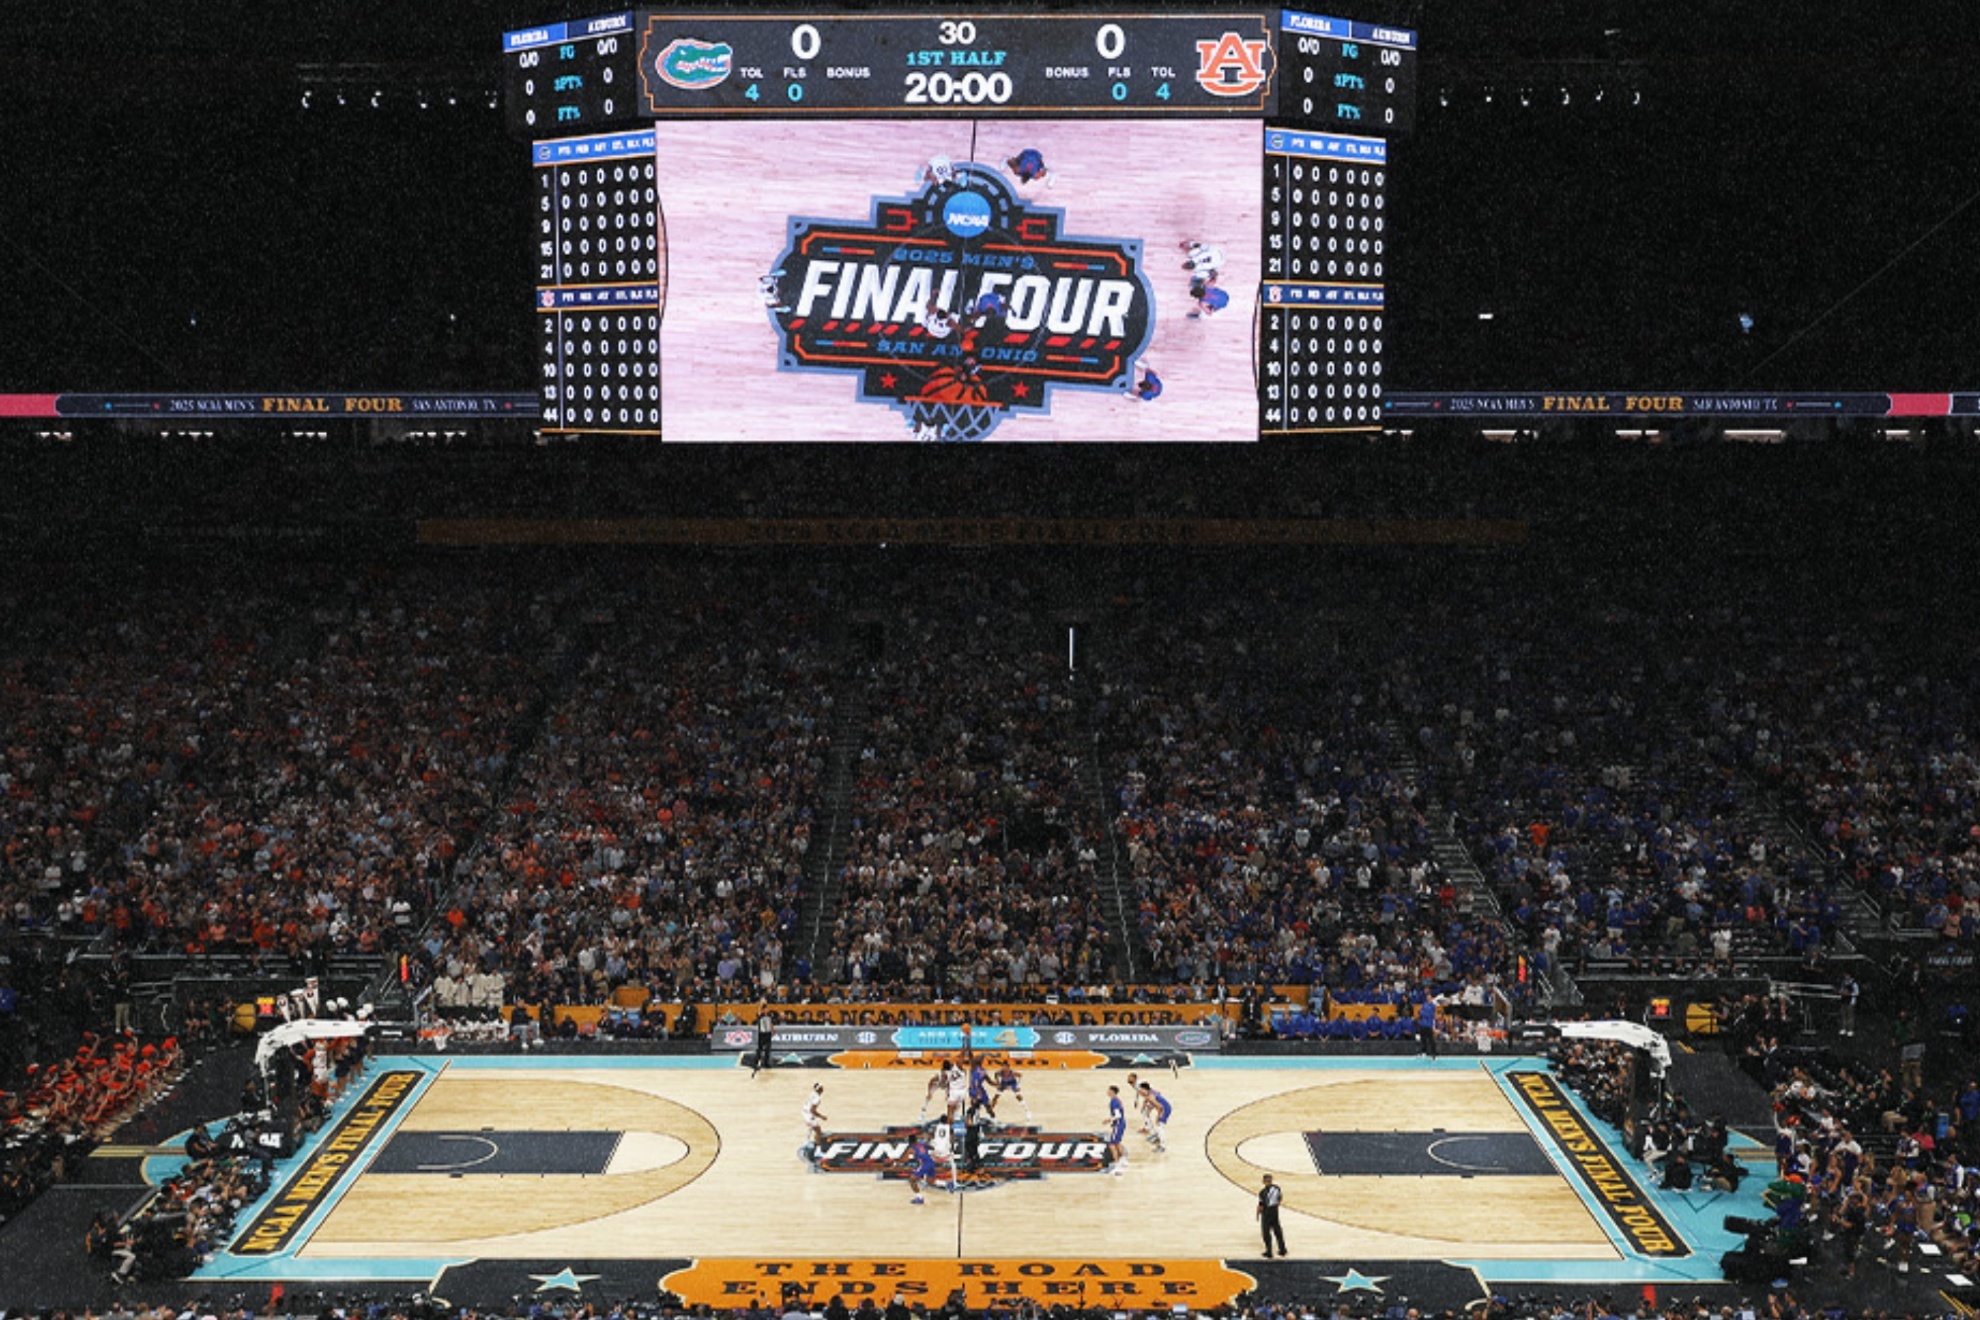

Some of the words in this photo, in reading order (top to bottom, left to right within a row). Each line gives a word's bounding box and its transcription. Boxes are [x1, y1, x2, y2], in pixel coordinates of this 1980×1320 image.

[791, 23, 821, 60] 0
[938, 21, 976, 44] 30
[1096, 23, 1126, 60] 0
[519, 51, 540, 68] 0/0
[597, 37, 617, 55] 0/0
[906, 51, 945, 66] 1ST
[951, 51, 1008, 66] HALF
[1297, 37, 1320, 55] 0/0
[1381, 49, 1401, 66] 0/0
[526, 80, 534, 95] 0
[603, 67, 613, 83] 0
[740, 67, 764, 79] TOL
[784, 67, 807, 79] FLS
[827, 67, 871, 79] BONUS
[1046, 67, 1089, 78] BONUS
[1108, 67, 1131, 78] FLS
[1151, 67, 1176, 78] TOL
[1304, 67, 1313, 83] 0
[1385, 77, 1395, 93] 0
[745, 84, 760, 101] 4
[787, 84, 803, 101] 0
[904, 71, 1013, 103] 20:00
[1112, 83, 1127, 100] 0
[1155, 83, 1171, 100] 4
[526, 109, 536, 125] 0
[604, 99, 613, 115] 0
[1303, 97, 1313, 114] 0
[1385, 107, 1394, 123] 0
[541, 174, 548, 188] 1
[561, 172, 570, 187] 0
[579, 170, 587, 185] 0
[596, 168, 606, 184] 0
[614, 167, 624, 182] 0
[629, 165, 639, 181] 0
[644, 164, 654, 179] 0
[1273, 163, 1279, 178] 1
[1293, 164, 1303, 180] 0
[1311, 166, 1320, 182] 0
[1329, 168, 1338, 183] 0
[1346, 169, 1355, 184] 0
[1361, 170, 1369, 186] 0
[1374, 172, 1384, 187] 0
[562, 240, 572, 255] 0
[580, 239, 589, 254] 0
[598, 238, 607, 253] 0
[616, 236, 625, 252] 0
[631, 236, 640, 251] 0
[646, 234, 655, 250] 0
[1292, 235, 1302, 251] 0
[1310, 236, 1320, 251] 0
[1328, 237, 1337, 252] 0
[1345, 238, 1354, 253] 0
[1359, 239, 1369, 254] 0
[1374, 240, 1383, 255] 0
[892, 247, 953, 263] 2025
[962, 252, 1035, 269] MEN'S
[795, 260, 960, 325] FINAL
[975, 271, 1134, 337] FOUR
[545, 318, 553, 333] 2
[564, 318, 574, 333] 0
[582, 317, 591, 332] 0
[599, 316, 609, 332] 0
[617, 316, 626, 332] 0
[633, 316, 642, 331] 0
[648, 315, 657, 330] 0
[1271, 314, 1279, 330] 2
[1291, 315, 1300, 330] 0
[1309, 315, 1318, 330] 0
[1327, 316, 1336, 331] 0
[1344, 316, 1354, 331] 0
[1359, 316, 1368, 331] 0
[1373, 316, 1382, 332] 0
[545, 341, 553, 355] 4
[877, 339, 924, 354] SAN
[932, 342, 1038, 363] ANONIO
[1269, 338, 1279, 353] 4
[262, 398, 329, 412] FINAL
[345, 398, 403, 412] FOUR
[483, 399, 496, 411] TX
[1543, 397, 1610, 411] FINAL
[1625, 397, 1683, 411] FOUR
[543, 408, 558, 422] 44
[1265, 408, 1281, 422] 44
[772, 1033, 839, 1042] AUBURN
[993, 1029, 1018, 1047] 4
[1089, 1033, 1158, 1042] FLORIDA
[977, 1142, 1107, 1160] FOUR
[241, 1203, 308, 1251] NCAA
[285, 1153, 349, 1200] MEN'S
[1575, 1154, 1635, 1202] FINAL
[1614, 1204, 1676, 1252] FOUR
[755, 1263, 907, 1276] THE
[958, 1263, 1165, 1276] ROAD
[722, 1281, 929, 1294] ENDS
[981, 1281, 1197, 1294] HERE
